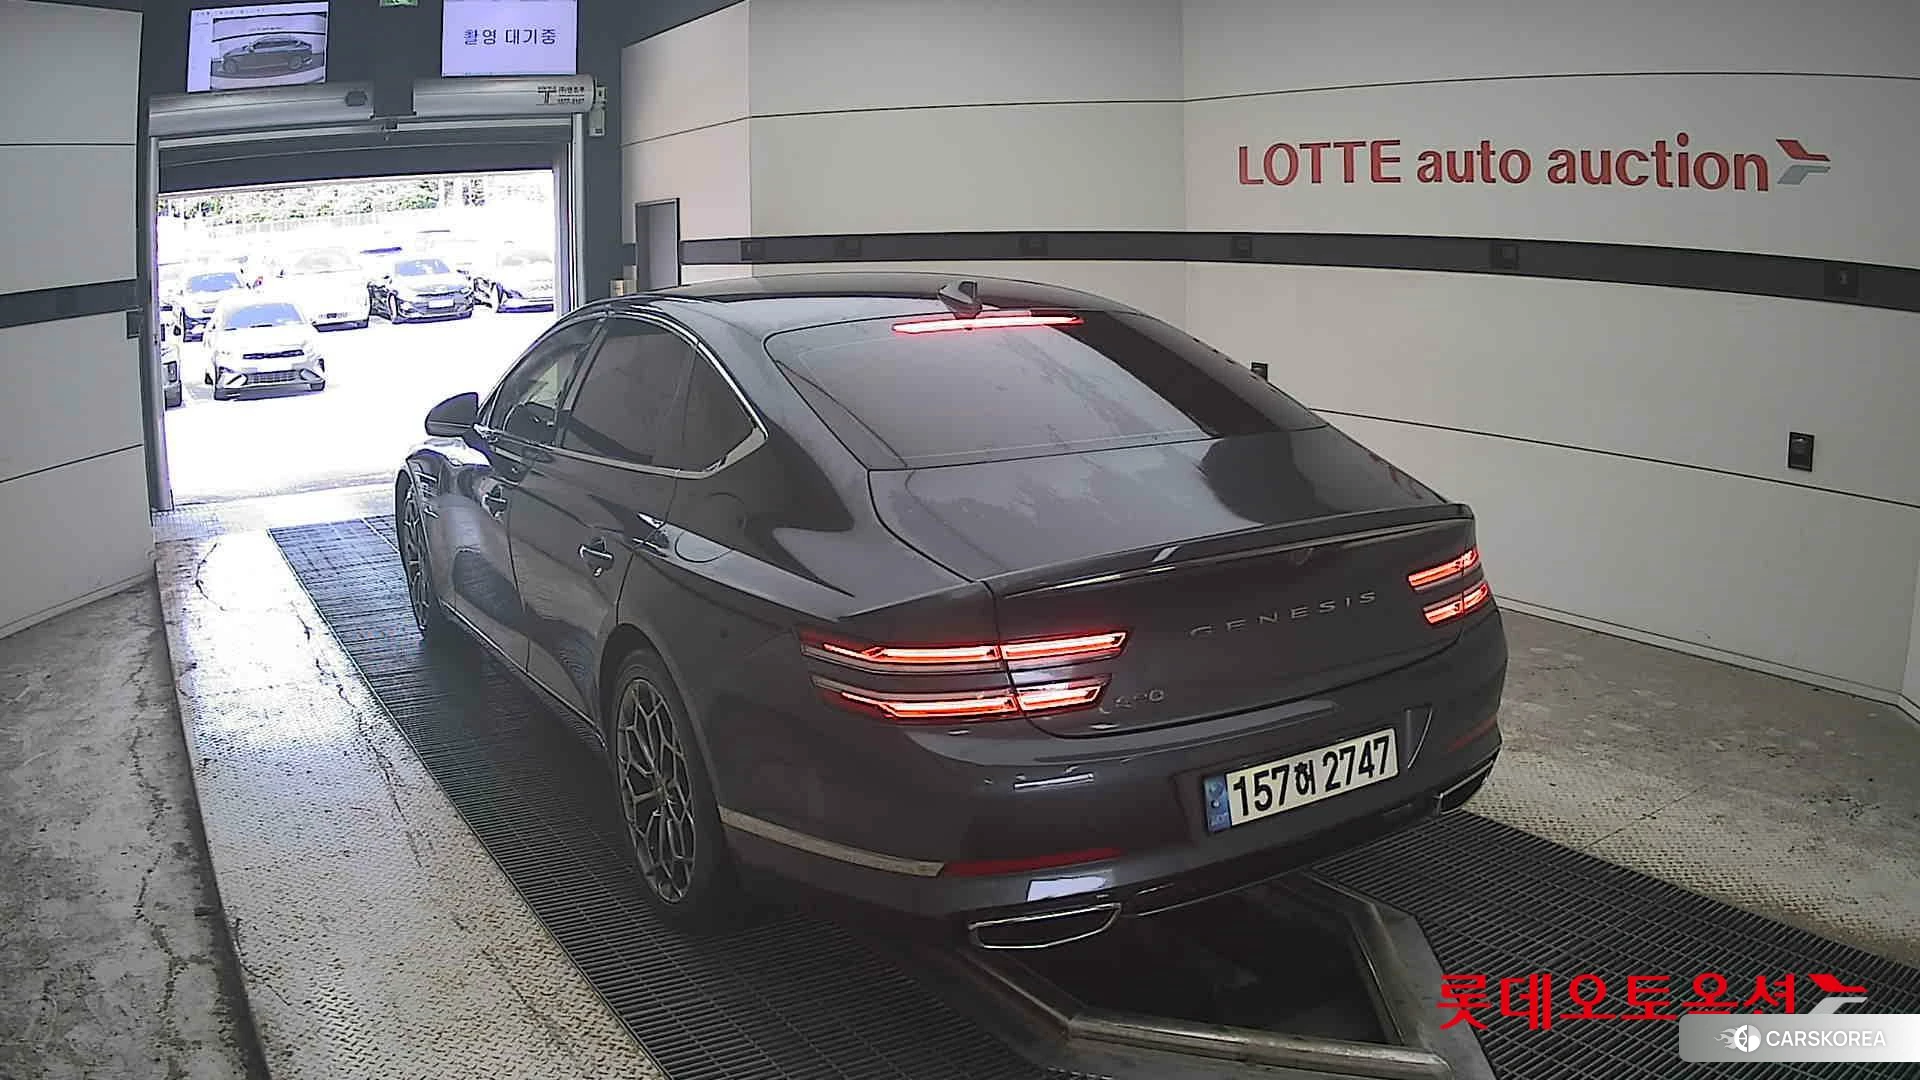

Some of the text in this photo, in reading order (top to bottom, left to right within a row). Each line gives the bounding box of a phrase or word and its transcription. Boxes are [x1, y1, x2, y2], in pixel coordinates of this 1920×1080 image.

[505, 29, 556, 45] 대기중
[1238, 132, 1769, 192] LOTTE auto auction
[1190, 591, 1377, 636] GENESIS
[1233, 735, 1390, 817] 157허 2747
